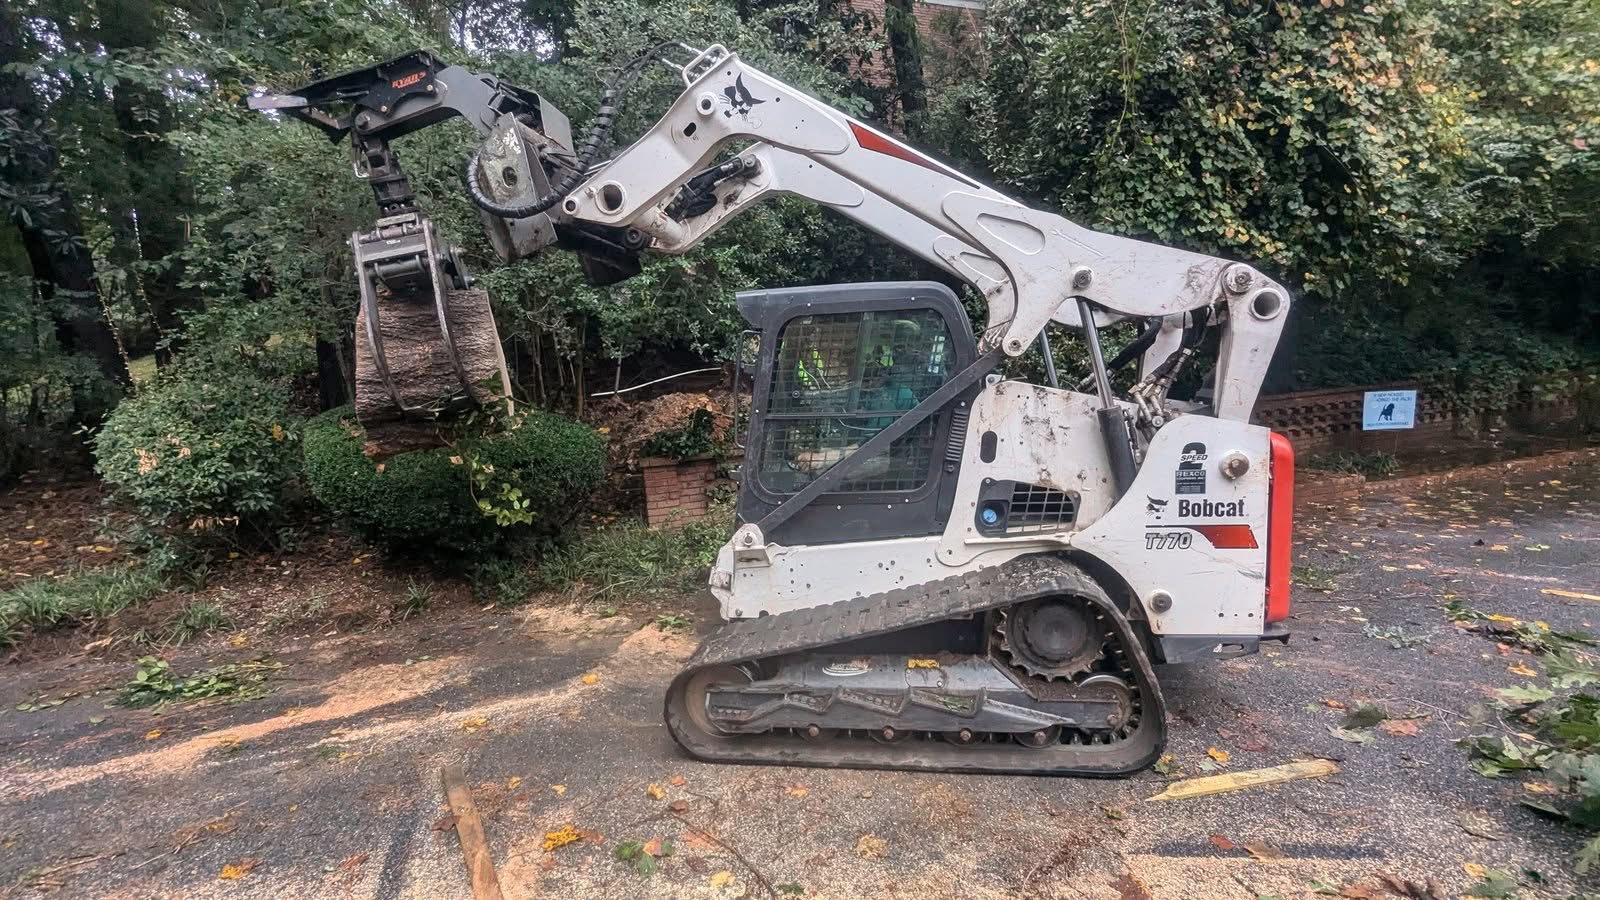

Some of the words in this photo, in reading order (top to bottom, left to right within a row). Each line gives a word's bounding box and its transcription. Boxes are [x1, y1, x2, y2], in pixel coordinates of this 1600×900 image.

[1178, 442, 1207, 470] 2
[1180, 454, 1208, 462] SPEED
[1178, 499, 1245, 518] Bobcat
[1145, 532, 1192, 550] T770
